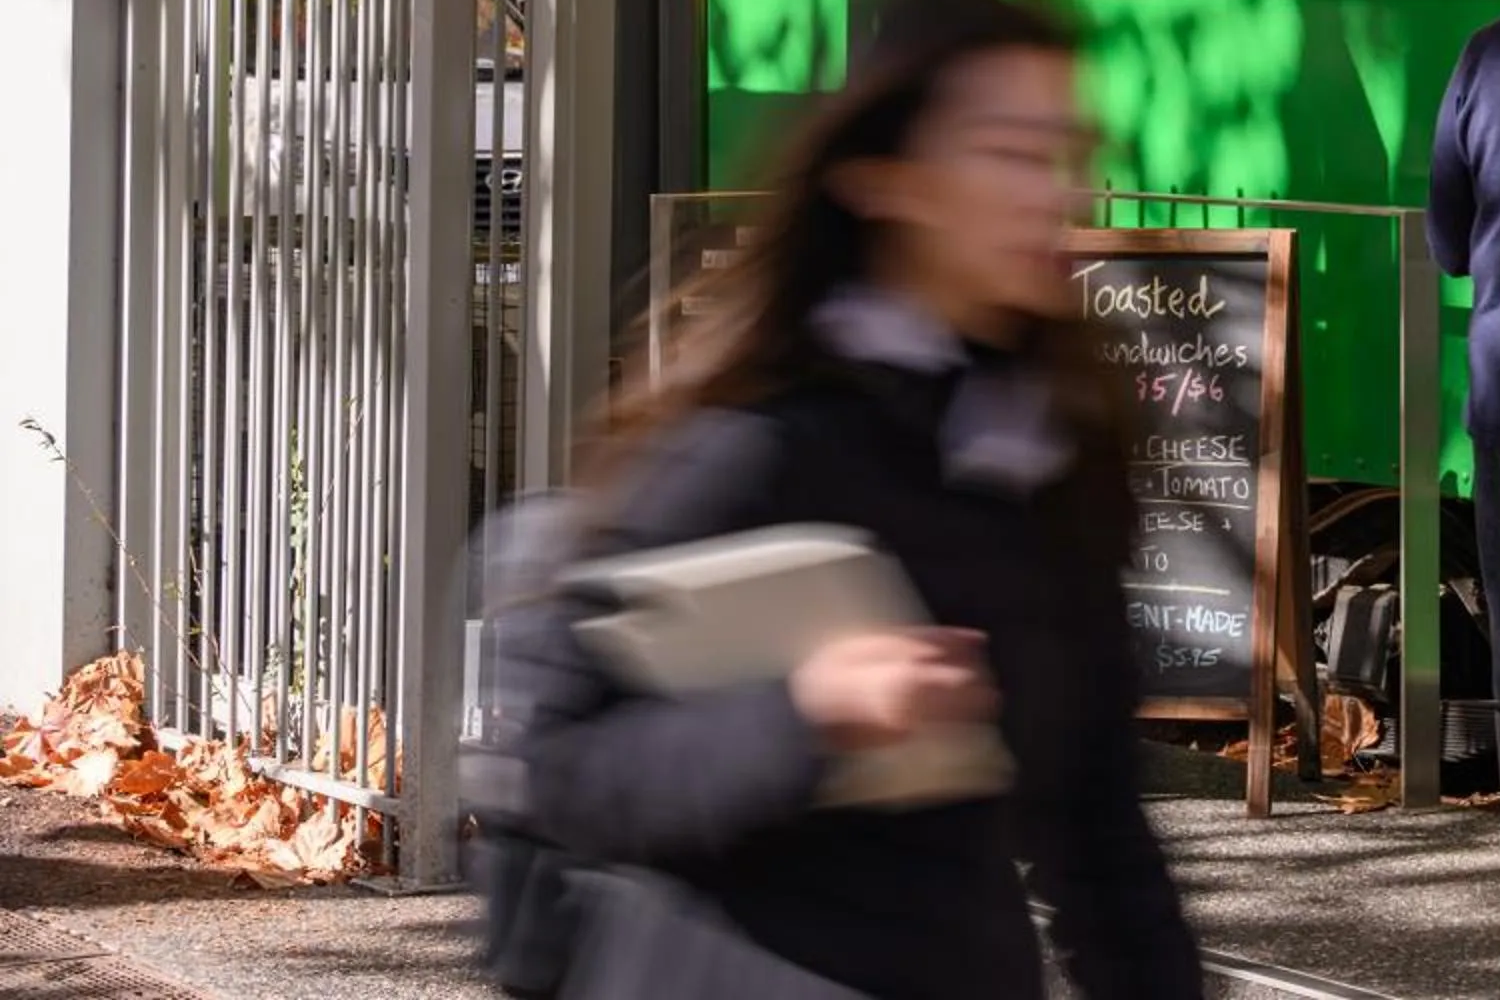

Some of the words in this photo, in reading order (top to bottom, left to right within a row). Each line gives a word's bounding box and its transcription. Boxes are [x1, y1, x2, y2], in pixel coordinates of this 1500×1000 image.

[1070, 260, 1226, 319] Toasted
[1092, 330, 1249, 368] andwiches
[1135, 367, 1225, 416] $5/$6
[1146, 434, 1249, 463] CHEESE
[1140, 511, 1204, 532] EESE
[1126, 602, 1248, 637] ENT-MADE
